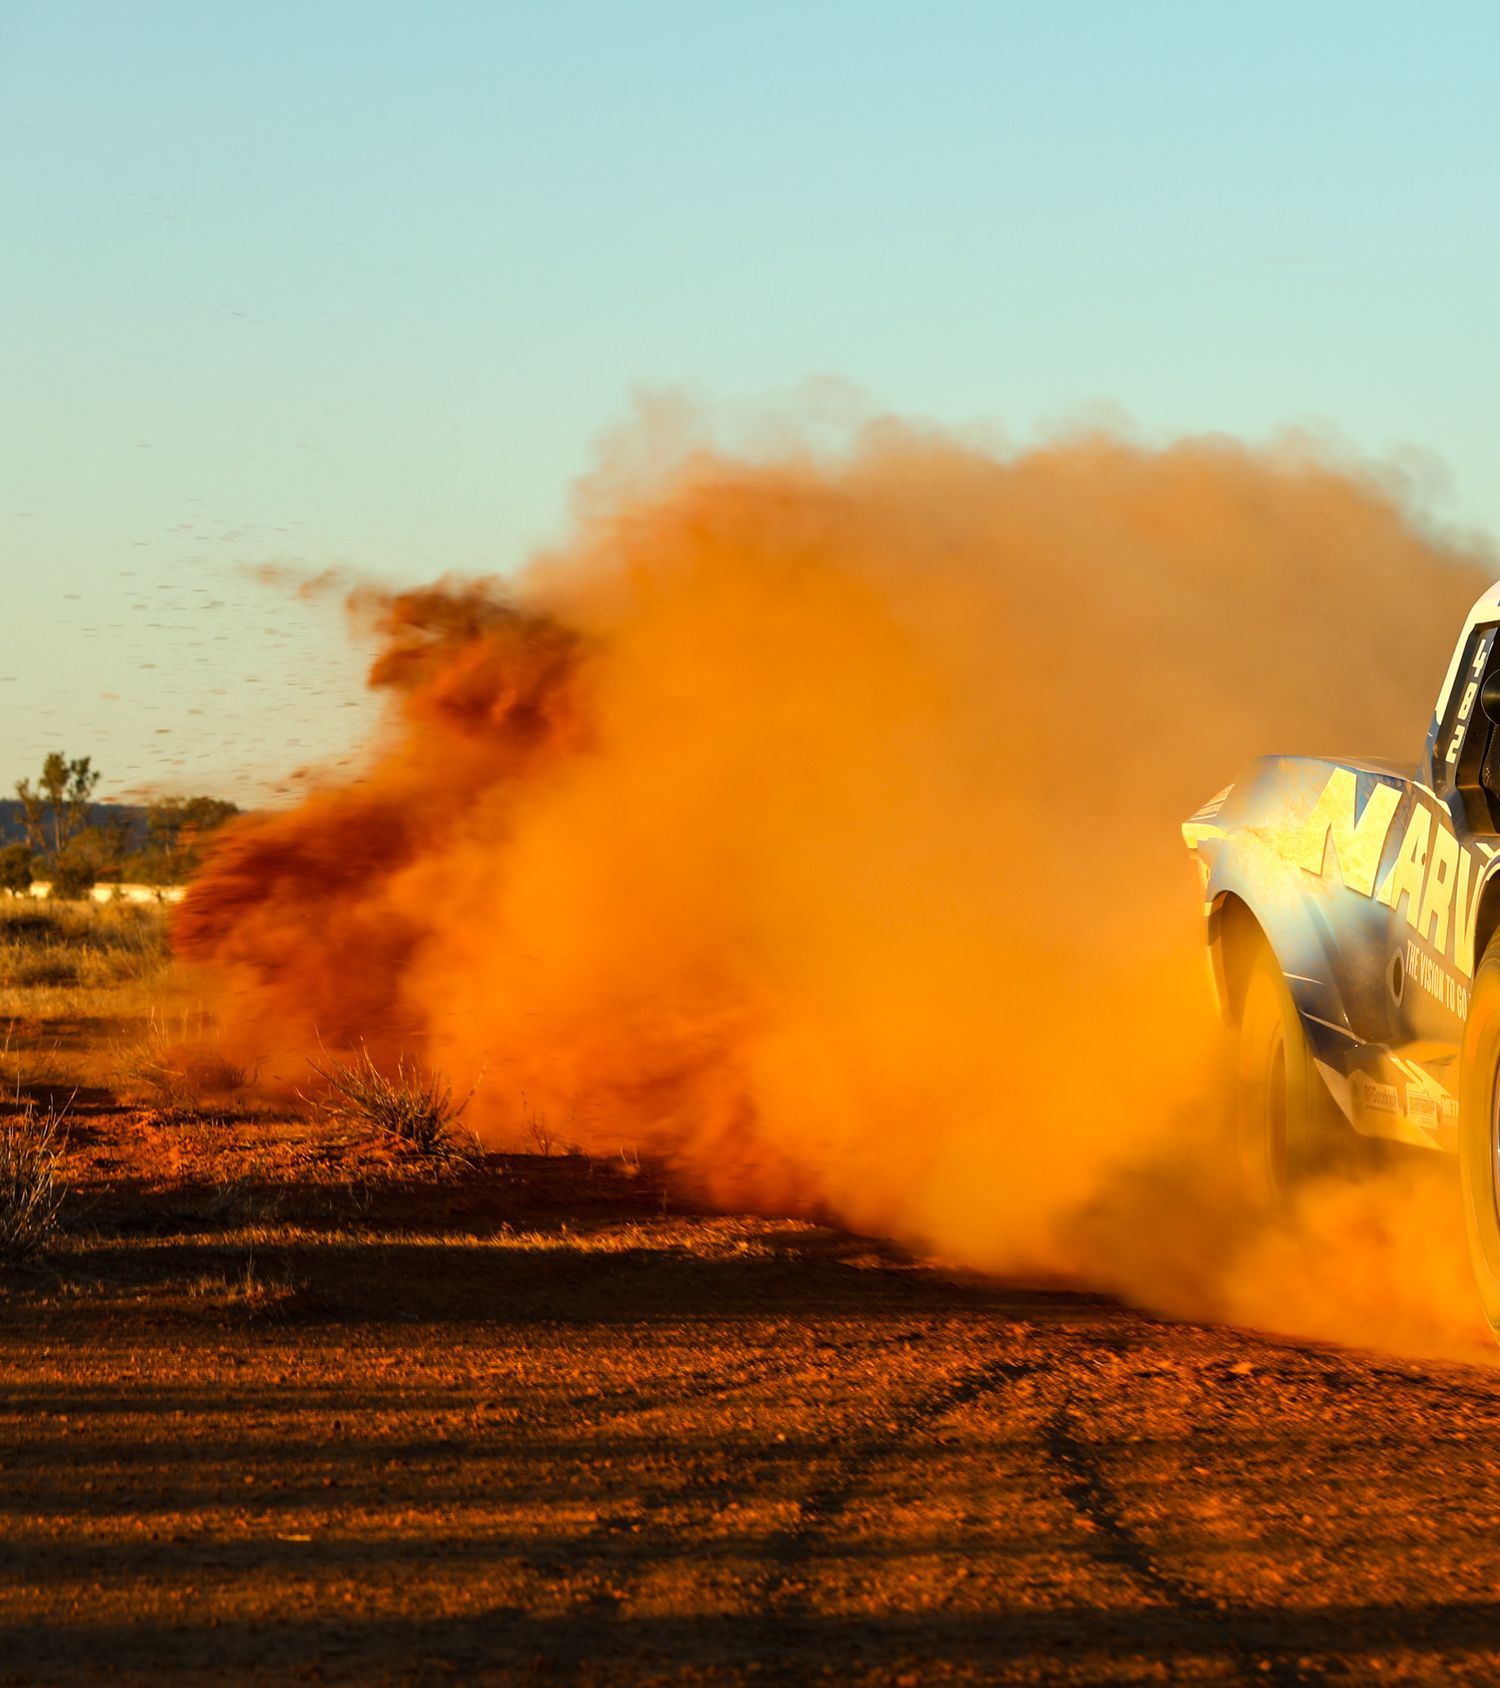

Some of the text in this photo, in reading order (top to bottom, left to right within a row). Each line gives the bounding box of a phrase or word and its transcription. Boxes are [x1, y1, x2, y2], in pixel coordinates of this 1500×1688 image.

[1445, 639, 1487, 764] 482
[1300, 767, 1492, 979] NARV
[1405, 939, 1468, 1022] THE VISION TO GO
